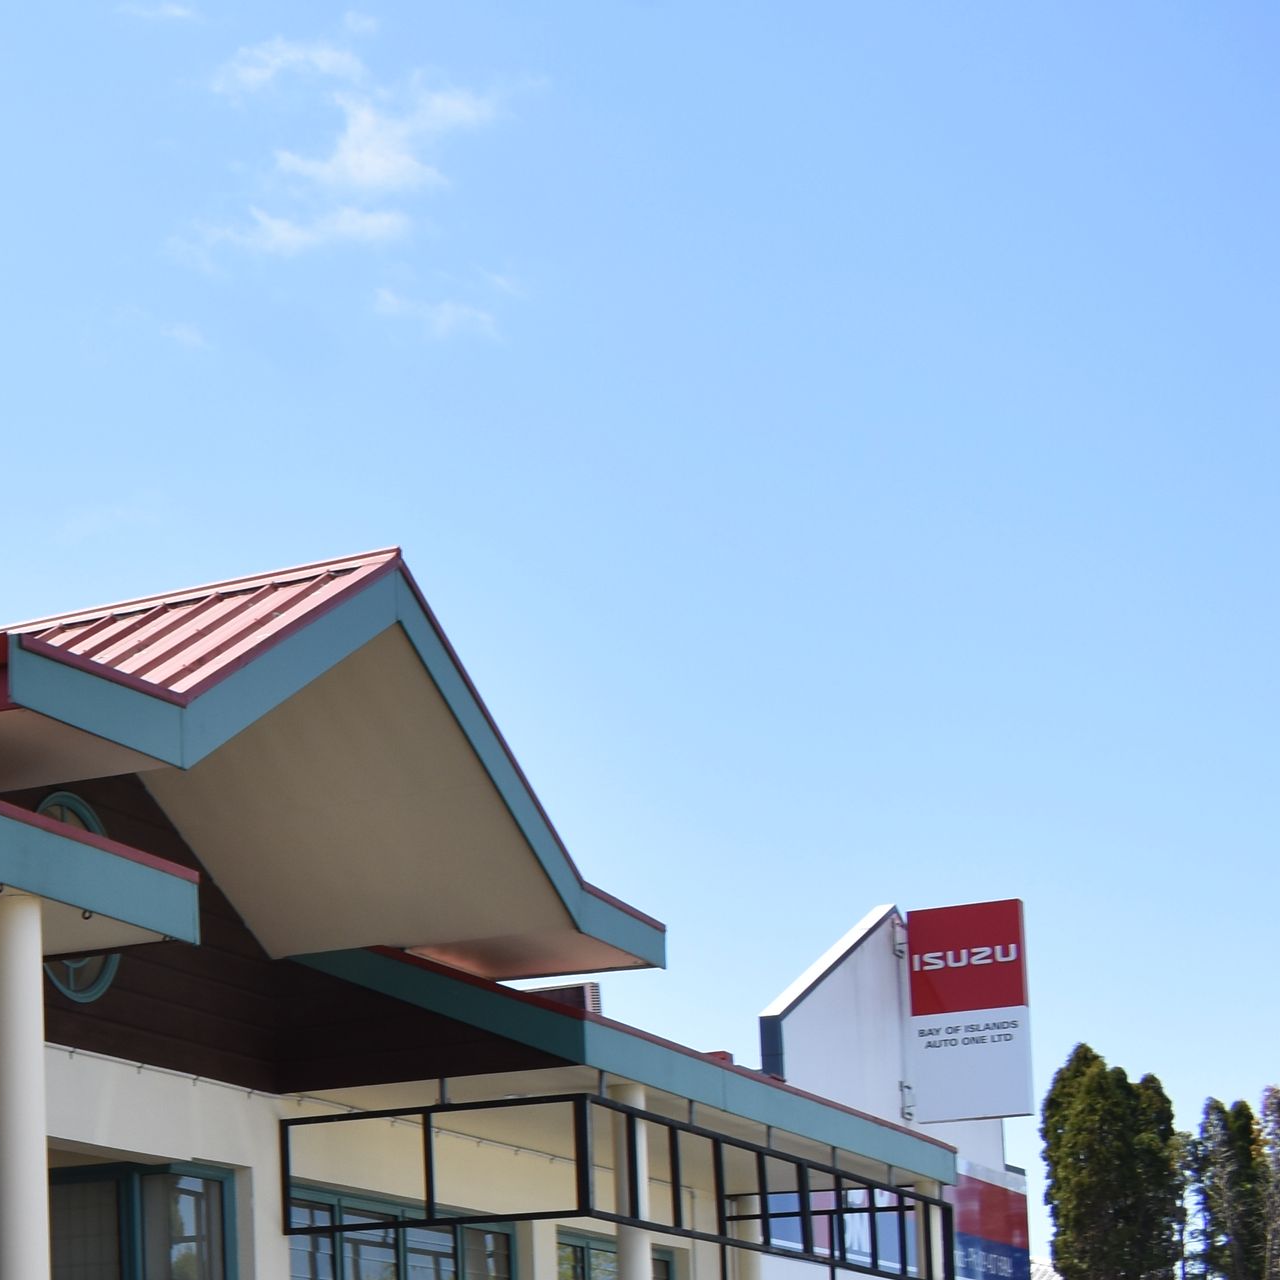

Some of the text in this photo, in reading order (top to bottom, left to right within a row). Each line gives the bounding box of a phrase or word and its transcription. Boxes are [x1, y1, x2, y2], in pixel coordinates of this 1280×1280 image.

[912, 943, 1018, 972] ISUZU
[917, 1020, 1019, 1038] BAY OF ISLANDS
[924, 1033, 1014, 1049] AUTO ONE LTD
